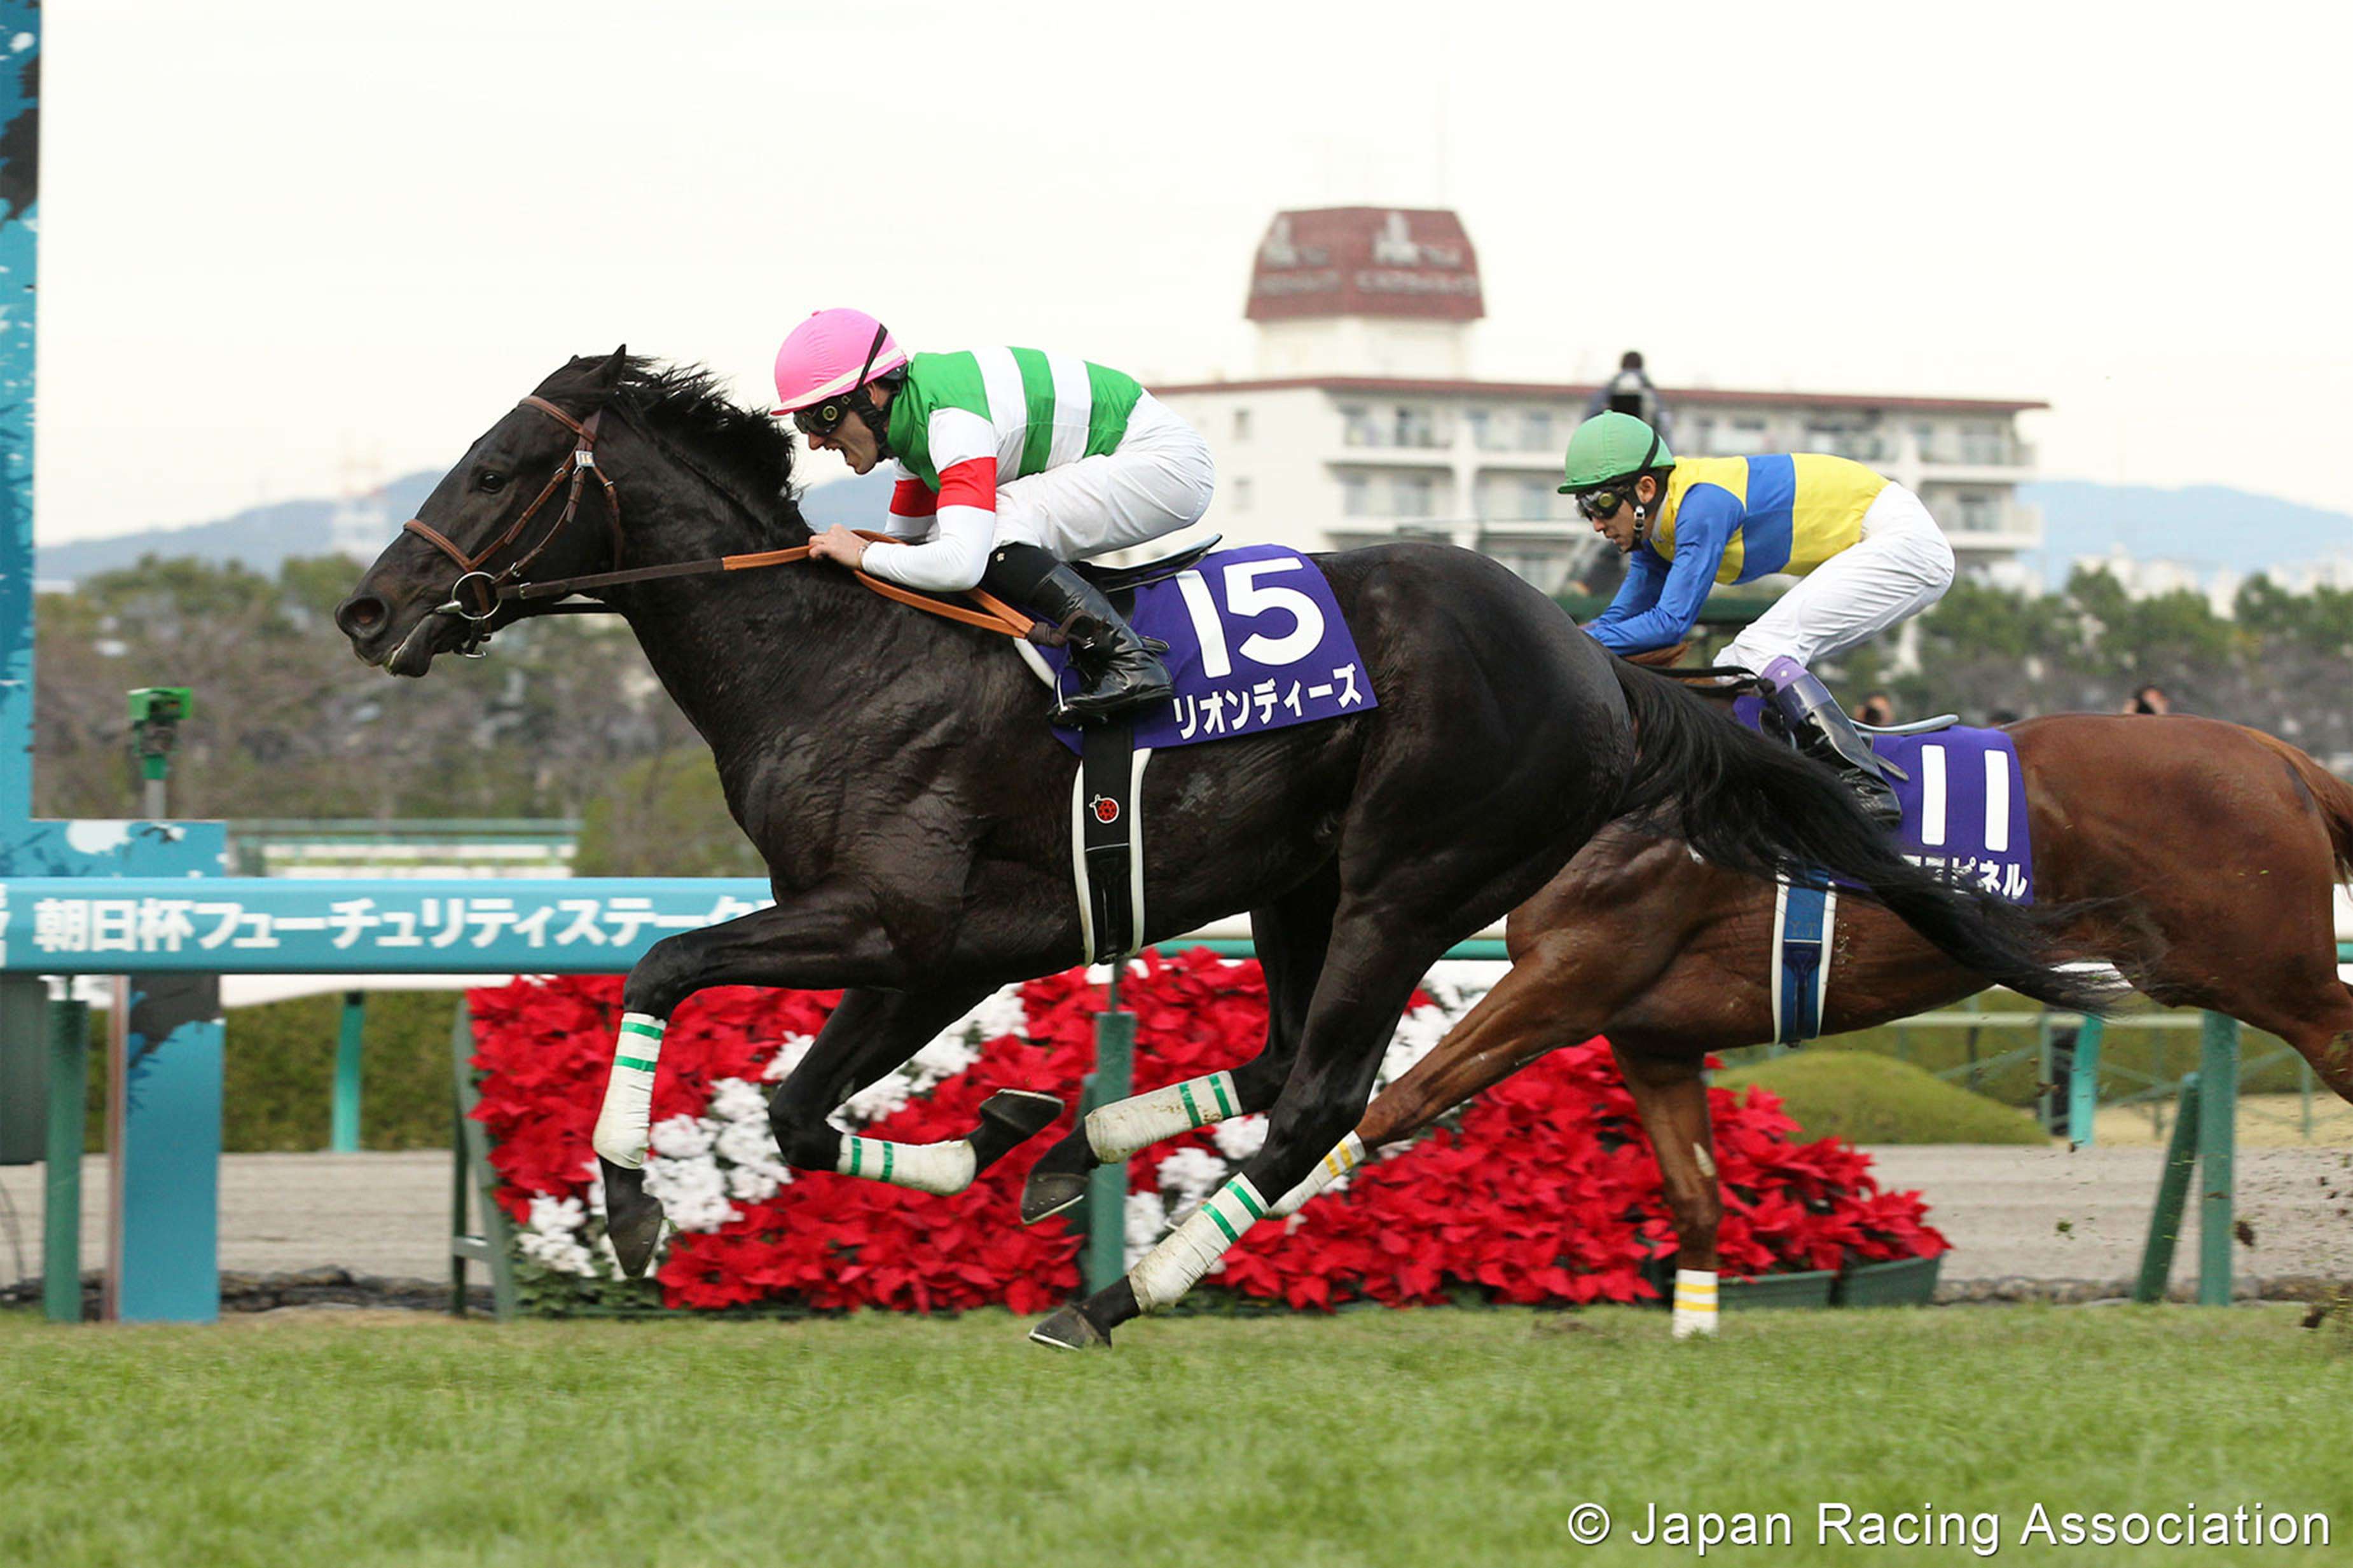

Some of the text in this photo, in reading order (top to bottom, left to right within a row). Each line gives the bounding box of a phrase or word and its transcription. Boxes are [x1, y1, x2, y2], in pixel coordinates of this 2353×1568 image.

[1176, 557, 1325, 678] 15
[1173, 663, 1363, 739] リオンディーズ
[1921, 745, 2010, 852] 11
